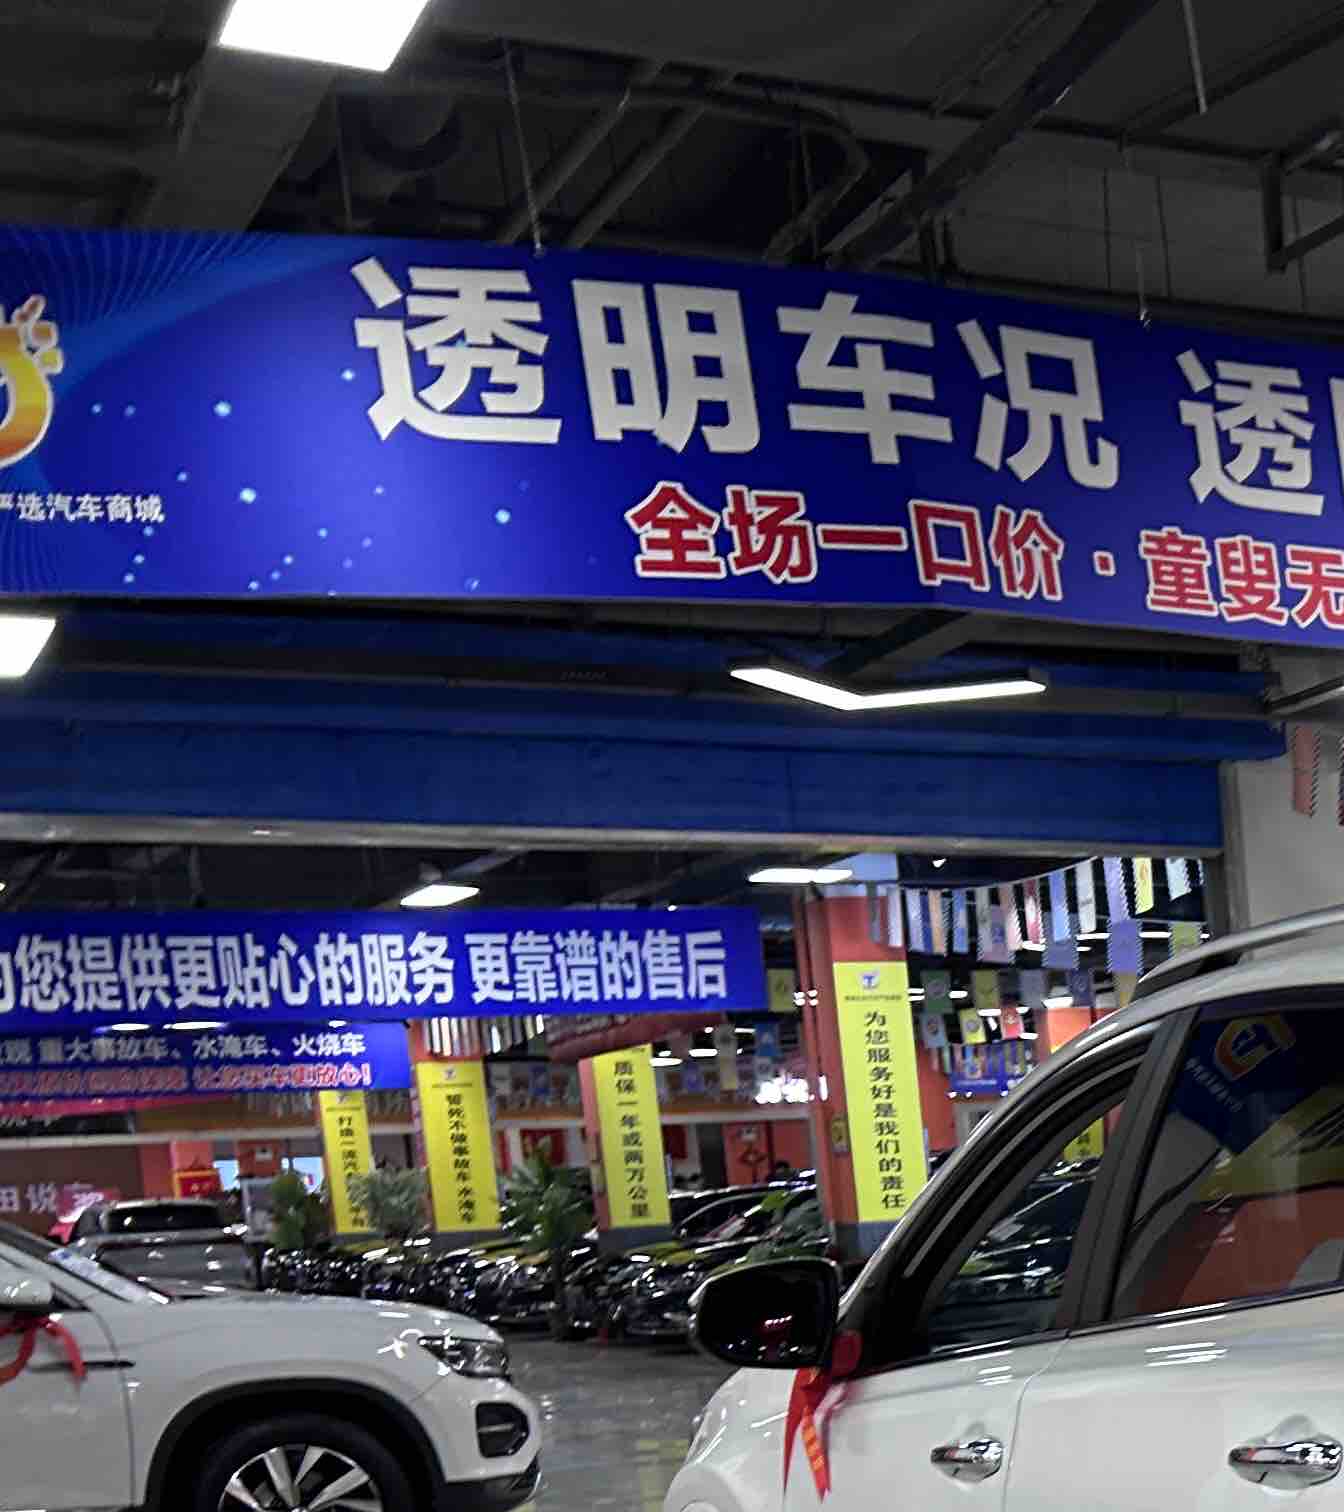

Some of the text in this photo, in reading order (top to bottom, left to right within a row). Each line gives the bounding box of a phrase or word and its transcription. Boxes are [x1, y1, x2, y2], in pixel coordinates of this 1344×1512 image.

[350, 255, 1119, 490] 透明车况
[0, 930, 728, 1014] 您提供更贴心的服务 更靠谱的售后
[613, 1061, 650, 1218] 质保一年或两万公里
[863, 1010, 906, 1210] 为您服务好是我们的责任
